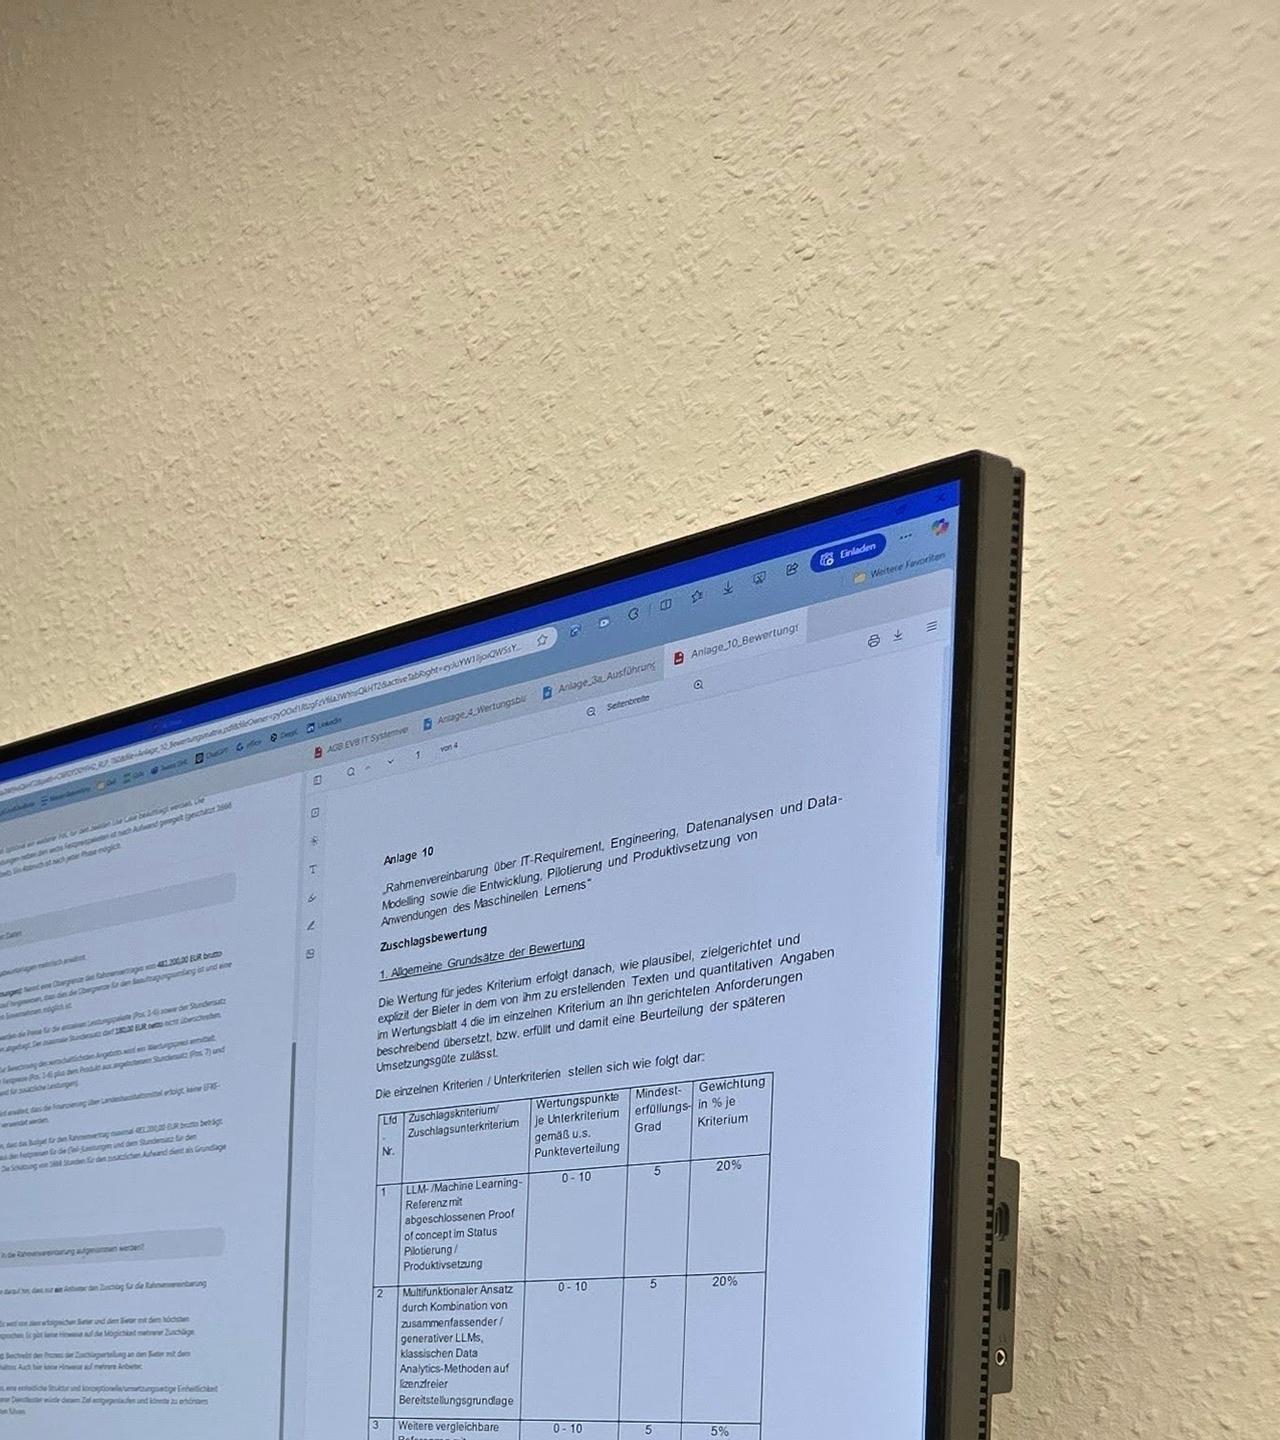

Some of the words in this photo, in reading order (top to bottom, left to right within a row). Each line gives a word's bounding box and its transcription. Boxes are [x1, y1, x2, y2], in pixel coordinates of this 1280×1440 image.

[840, 542, 877, 560] Einladen
[493, 859, 517, 872] über
[685, 808, 774, 834] Datenanalysen
[780, 799, 803, 815] und
[807, 794, 843, 810] Data-
[383, 851, 418, 866] Anlage
[421, 845, 434, 857] 10
[381, 894, 425, 911] Modelling
[429, 887, 459, 902] sowie
[461, 883, 477, 895] die
[547, 860, 602, 879] Pilotierung
[607, 852, 629, 867] und
[632, 835, 731, 863] Produktivsetzung
[736, 830, 758, 843] von
[380, 906, 448, 927] Anwendungen
[452, 902, 471, 913] des
[473, 889, 539, 910] Maschinellen
[379, 925, 487, 952] Zuschlagsbewertung
[390, 961, 443, 979] Allgemeine
[447, 951, 505, 968] Grundsätze
[508, 947, 526, 958] der
[528, 938, 585, 957] Bewertung
[378, 996, 395, 1008] Die
[396, 991, 438, 1005] Wertung
[440, 987, 456, 998] für
[454, 983, 483, 999] jedes
[486, 976, 532, 992] Kriterium
[535, 969, 569, 984] erfolgt
[571, 962, 615, 979] danach,
[619, 958, 639, 971] wie
[641, 949, 695, 971] plausibel,
[699, 937, 773, 960] zielgerichtet
[777, 932, 800, 947] und
[377, 1009, 410, 1025] explizit
[412, 1007, 429, 1019] der
[431, 1003, 460, 1016] Bieter
[463, 1000, 472, 1011] in
[474, 998, 497, 1009] dem
[499, 995, 519, 1006] von
[522, 991, 541, 1003] ihm
[543, 989, 558, 1000] zu
[560, 979, 626, 997] erstellenden
[630, 972, 669, 987] Texten
[674, 966, 695, 981] und
[699, 957, 773, 979] quantitativen
[778, 948, 834, 966] Angaben
[377, 1030, 389, 1040] im
[390, 1019, 457, 1038] Wertungsblatt
[460, 1017, 467, 1028] 4
[470, 1015, 485, 1027] die
[488, 1013, 501, 1025] im
[503, 1007, 553, 1023] einzelnen
[557, 999, 605, 1015] Kriterium
[608, 997, 623, 1008] an
[626, 993, 644, 1005] ihn
[646, 985, 710, 1006] gerichteten
[713, 971, 803, 994] Anforderungen
[376, 1038, 440, 1057] beschreibend
[495, 1029, 520, 1041] bzw.
[522, 1023, 551, 1037] erfüllt
[555, 1019, 576, 1033] und
[578, 1015, 609, 1030] damit
[612, 1013, 635, 1025] eine
[639, 1004, 704, 1022] Beurteilung
[709, 1000, 729, 1013] der
[732, 993, 785, 1012] späteren
[376, 1053, 456, 1072] Umsetzungsgüte
[375, 1088, 391, 1099] Die
[393, 1083, 439, 1097] einzelnen
[442, 1077, 483, 1092] Kriterien
[493, 1068, 561, 1086] Unterkriterien
[567, 1064, 603, 1077] stellen
[606, 1059, 629, 1073] sich
[632, 1057, 652, 1070] wie
[655, 1053, 679, 1069] folgt
[682, 1051, 705, 1064] dar:
[635, 1085, 682, 1099] Mindest-
[698, 1077, 766, 1093] Gewichtung
[535, 1092, 620, 1109] Wertungspunkte
[634, 1102, 690, 1116] erfüllungs-
[533, 1114, 544, 1128] je
[547, 1108, 620, 1125] Unterkriterium
[697, 1113, 748, 1127] Kriterium
[407, 1118, 519, 1138] Zuschlagsunterkriterium
[634, 1120, 662, 1133] Grad
[534, 1128, 570, 1145] gemäß
[571, 1129, 591, 1139] u.s.
[534, 1142, 620, 1158] Punkteverteilung
[475, 1178, 523, 1190] Learning-
[404, 1198, 448, 1210] Referenz
[448, 1196, 463, 1207] mit
[404, 1212, 486, 1227] abgeschlossenen
[487, 1207, 515, 1220] Proof
[403, 1230, 414, 1241] of
[414, 1229, 452, 1241] concept
[453, 1228, 465, 1238] im
[466, 1227, 497, 1237] Status
[403, 1244, 453, 1257] Pilotierung
[403, 1259, 483, 1271] Produktivsetzung
[402, 1285, 479, 1297] Multifunktionaler
[478, 1284, 514, 1295] Ansatz
[401, 1302, 428, 1313] durch
[429, 1300, 488, 1312] Kombination
[489, 1301, 508, 1310] von
[400, 1316, 498, 1329] zusammenfassender
[400, 1332, 454, 1346] generativer
[400, 1348, 454, 1359] klassischen
[455, 1347, 478, 1358] Data
[399, 1363, 492, 1376] Analytics-Methoden
[493, 1362, 510, 1373] auf
[398, 1394, 514, 1408] Bereitstellungsgrundlage
[397, 1420, 434, 1431] Weitere
[435, 1421, 499, 1434] vergleichbare
